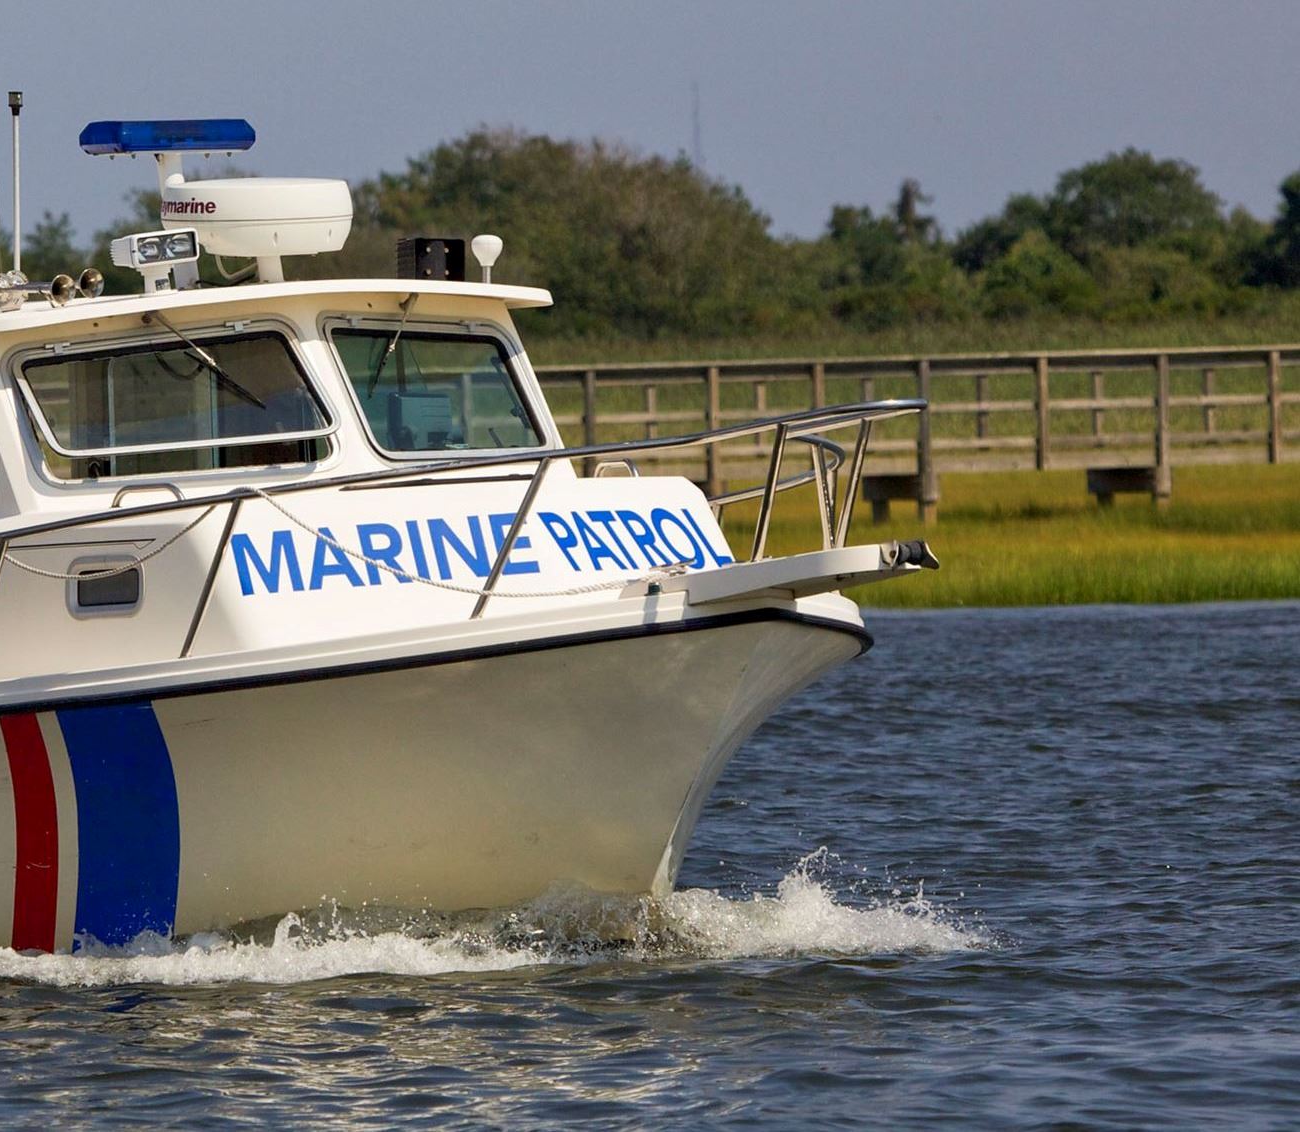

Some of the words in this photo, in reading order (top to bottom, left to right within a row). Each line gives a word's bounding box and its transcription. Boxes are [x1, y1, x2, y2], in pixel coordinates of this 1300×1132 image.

[161, 197, 216, 216] ymarine
[231, 512, 540, 596] MARINE
[537, 508, 732, 571] PATROL
